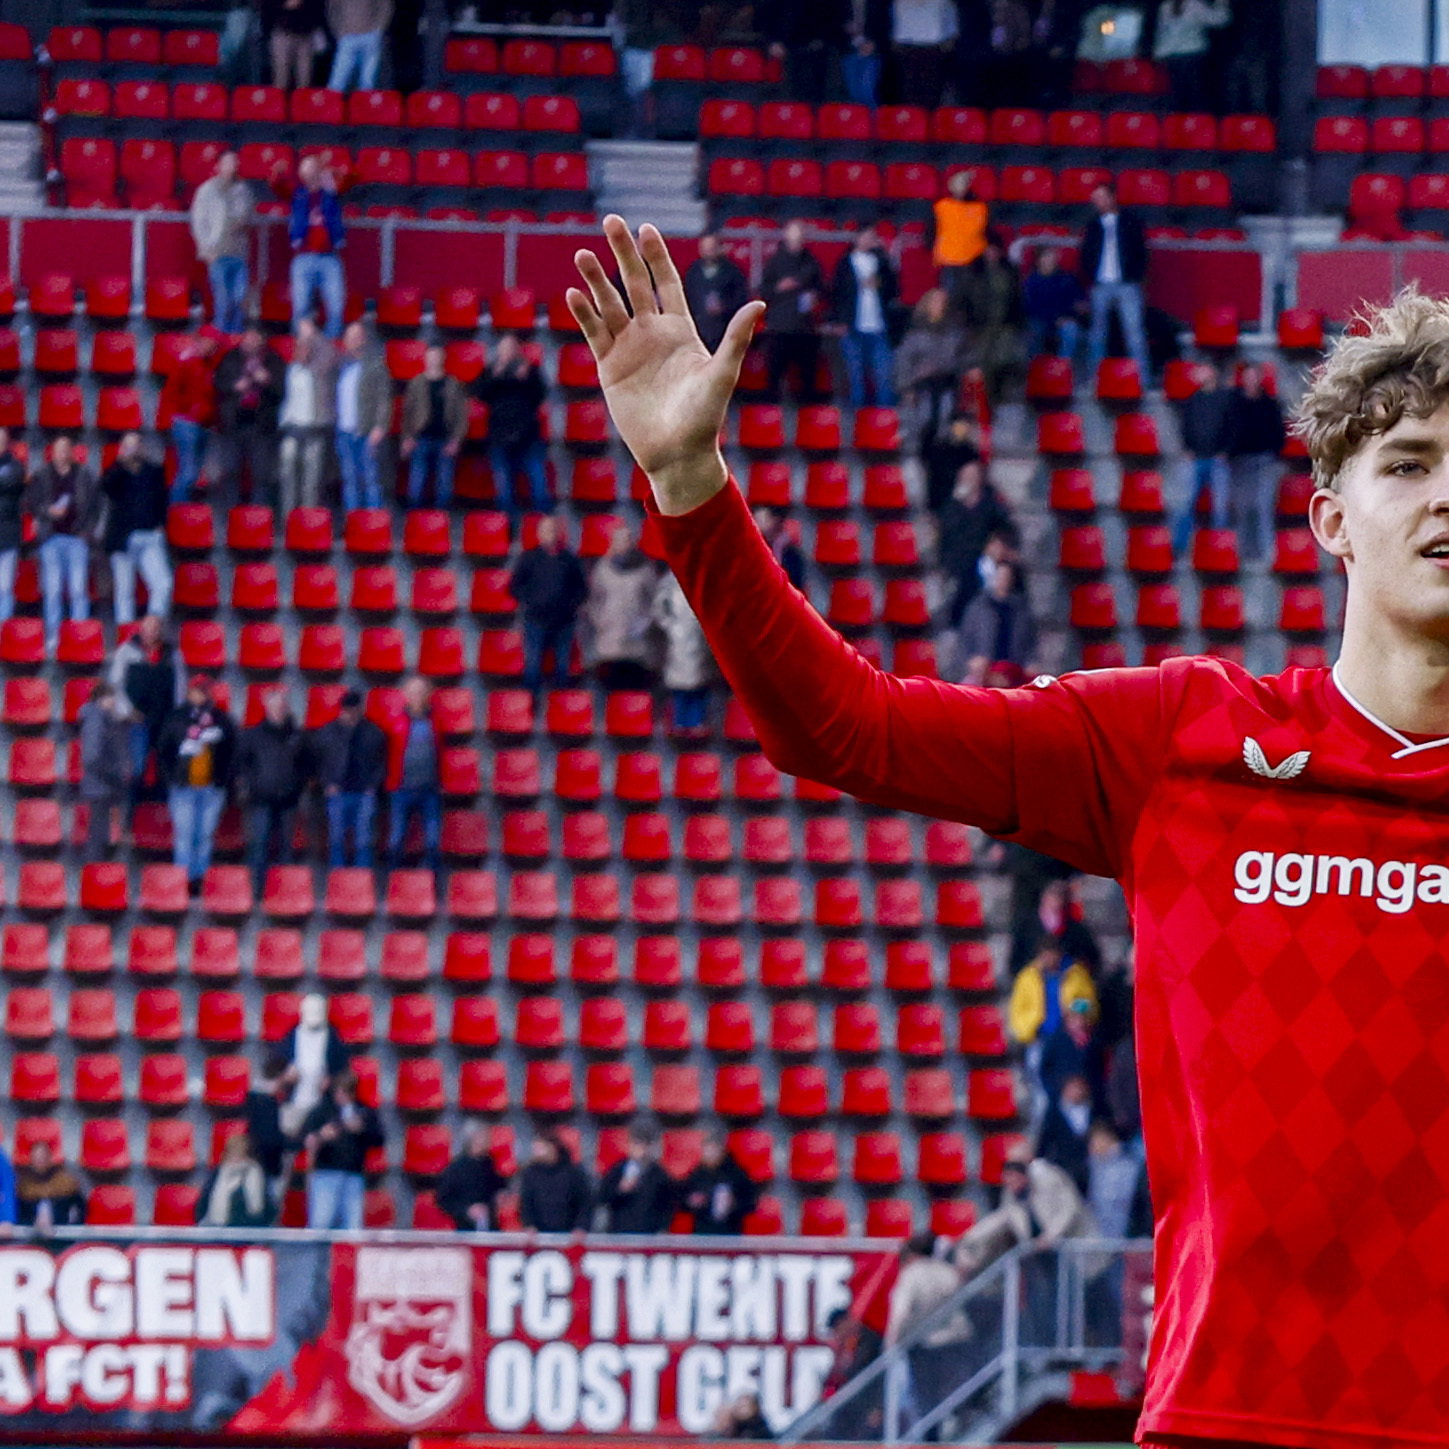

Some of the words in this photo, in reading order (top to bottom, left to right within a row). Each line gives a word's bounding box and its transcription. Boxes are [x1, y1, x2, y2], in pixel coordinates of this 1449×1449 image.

[0, 1246, 273, 1340] RGEN
[486, 1249, 573, 1340] FC
[45, 1343, 189, 1404] FCT!
[484, 1338, 669, 1433] OOST
